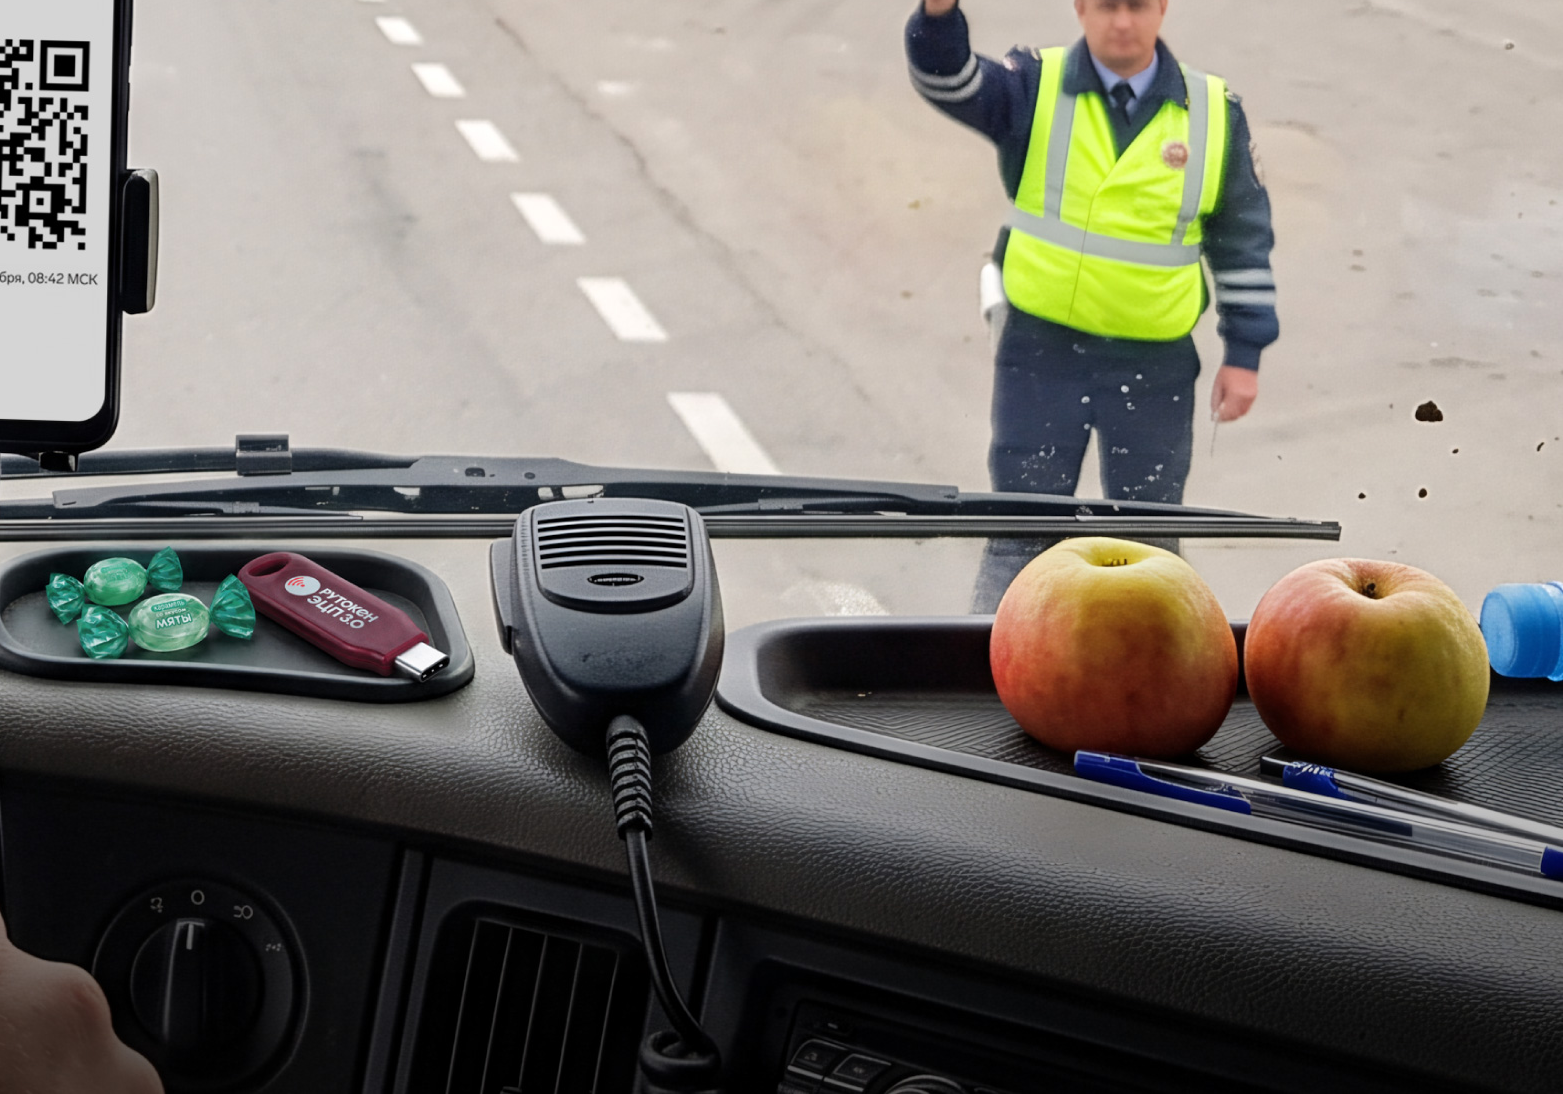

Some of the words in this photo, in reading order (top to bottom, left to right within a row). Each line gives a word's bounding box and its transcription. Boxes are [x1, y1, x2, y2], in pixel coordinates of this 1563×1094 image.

[27, 272, 64, 284] 08:42
[67, 273, 98, 285] МСК
[307, 595, 345, 618] ЭЦП
[339, 613, 365, 629] 3.0
